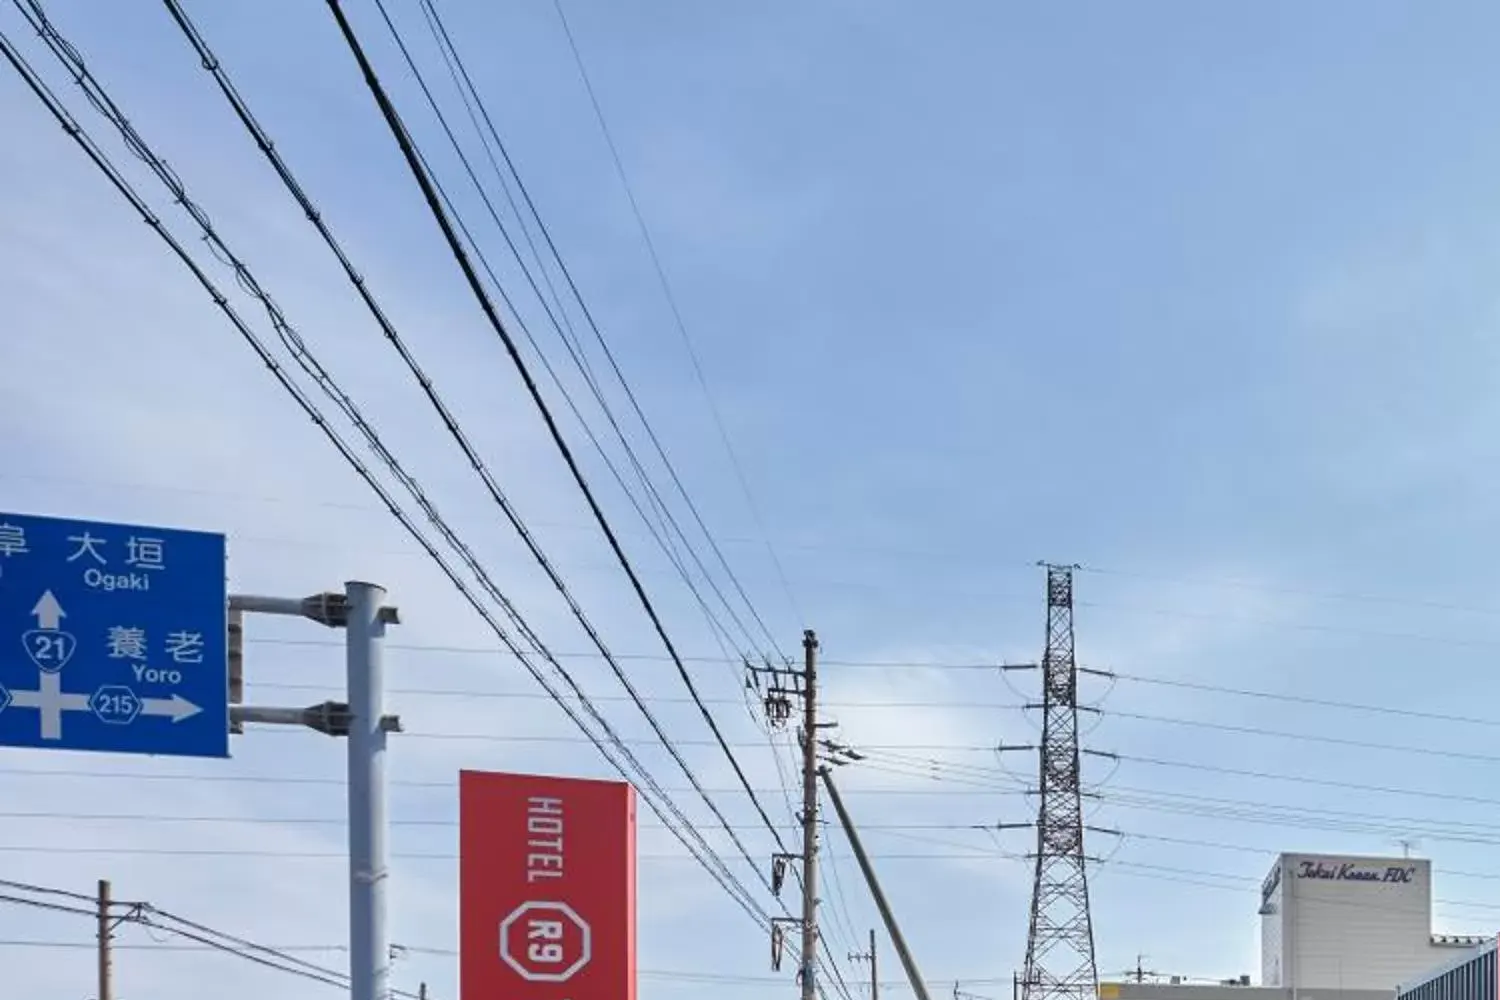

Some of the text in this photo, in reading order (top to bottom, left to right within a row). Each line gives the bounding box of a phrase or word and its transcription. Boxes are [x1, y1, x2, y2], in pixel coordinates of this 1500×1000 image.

[66, 531, 166, 570] 大垣
[83, 569, 150, 592] Ogaki
[34, 636, 66, 660] 21
[106, 626, 205, 664] 養老
[131, 664, 182, 685] Yoro
[98, 694, 134, 715] 215
[527, 797, 563, 882] HOTEL
[528, 920, 563, 962] R9
